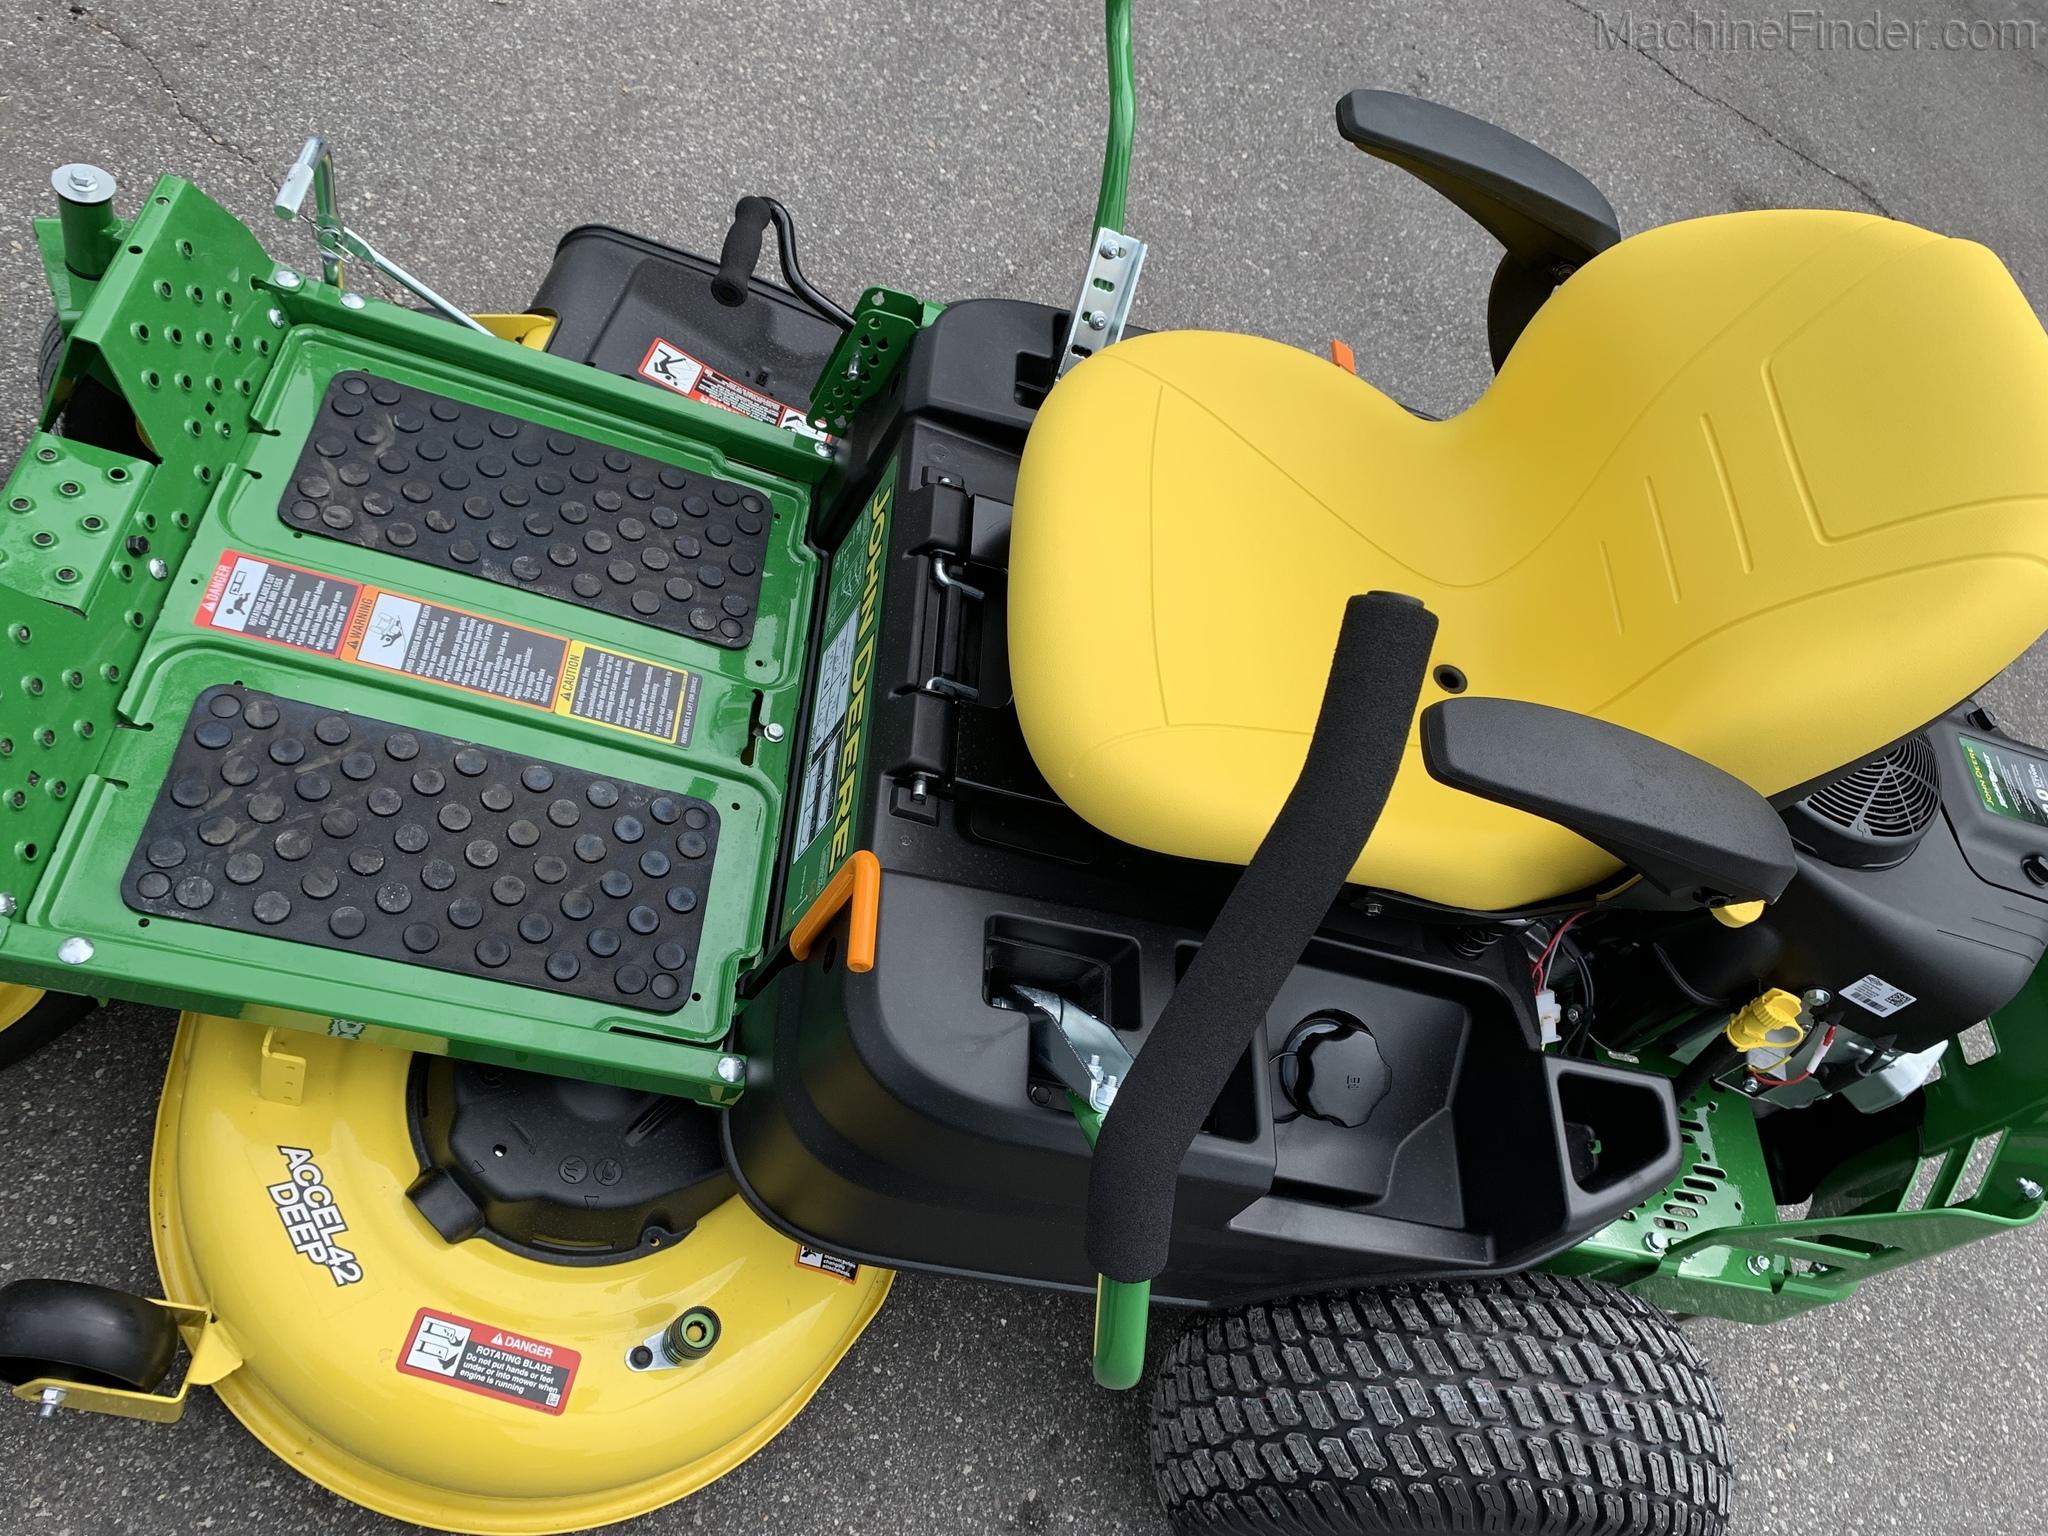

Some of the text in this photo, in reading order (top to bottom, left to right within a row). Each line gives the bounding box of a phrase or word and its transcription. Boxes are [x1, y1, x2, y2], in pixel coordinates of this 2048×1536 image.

[858, 487, 890, 642] JOHN
[205, 564, 231, 601] DANGER
[248, 572, 275, 626] ROTATING BLADES CUT
[258, 577, 283, 626] OFF ARMS AND LEGS
[420, 604, 431, 618] DEATH
[349, 596, 373, 639] WARNING
[413, 624, 425, 640] INJURY
[404, 658, 415, 672] AVOID
[408, 640, 420, 659] SERIOUS
[562, 654, 580, 691] CAUTION
[829, 633, 874, 874] DEERE
[1967, 746, 1994, 806] JOHN DEERE
[267, 1181, 328, 1264] DEEP
[823, 1260, 845, 1270] changing
[475, 1345, 553, 1374] ROTATING BLADE
[504, 1336, 552, 1359] DANGER
[459, 1369, 524, 1394] engine is running
[462, 1361, 485, 1373] under
[495, 1370, 510, 1380] into
[511, 1375, 537, 1388] mower
[537, 1382, 558, 1393] when
[465, 1353, 554, 1384] Do not put hands or feet
